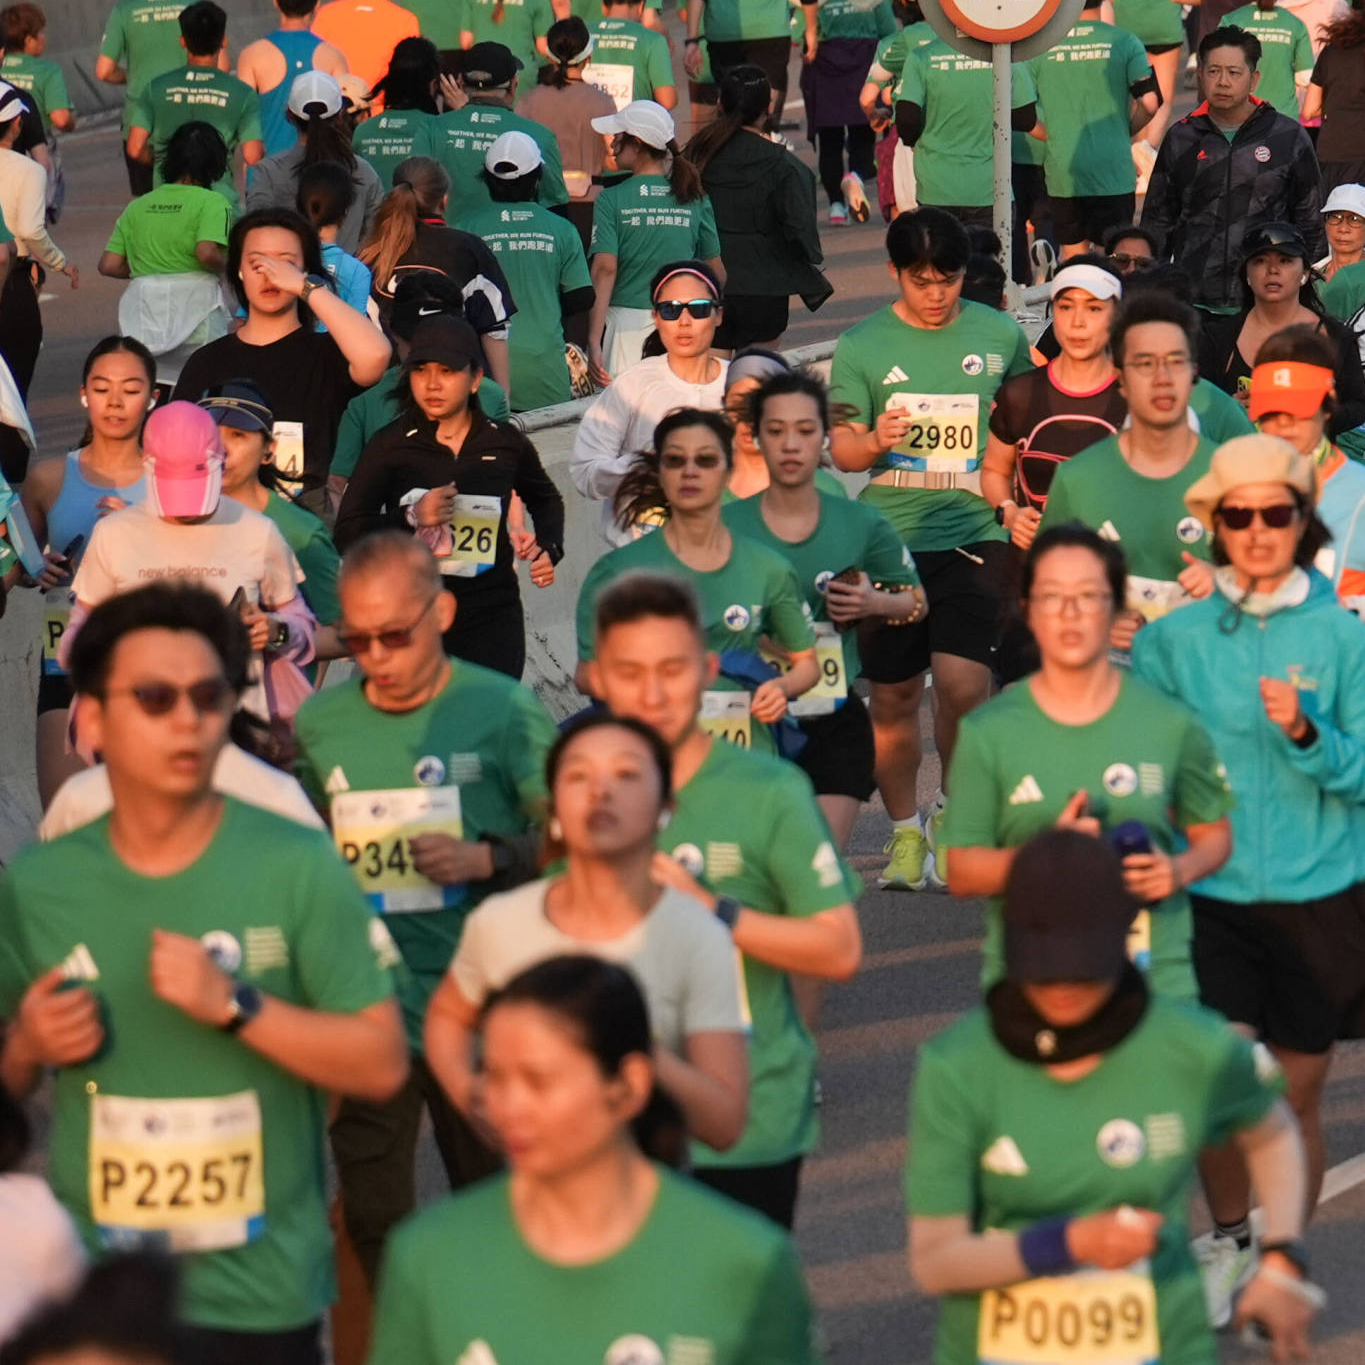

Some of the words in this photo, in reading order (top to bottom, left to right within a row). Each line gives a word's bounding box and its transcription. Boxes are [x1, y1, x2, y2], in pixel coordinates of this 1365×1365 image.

[909, 424, 973, 449] 2980
[138, 569, 164, 579] new
[167, 567, 227, 579] balance
[342, 838, 413, 879] P34
[100, 1155, 253, 1209] P2257
[994, 1289, 1145, 1347] P0099
